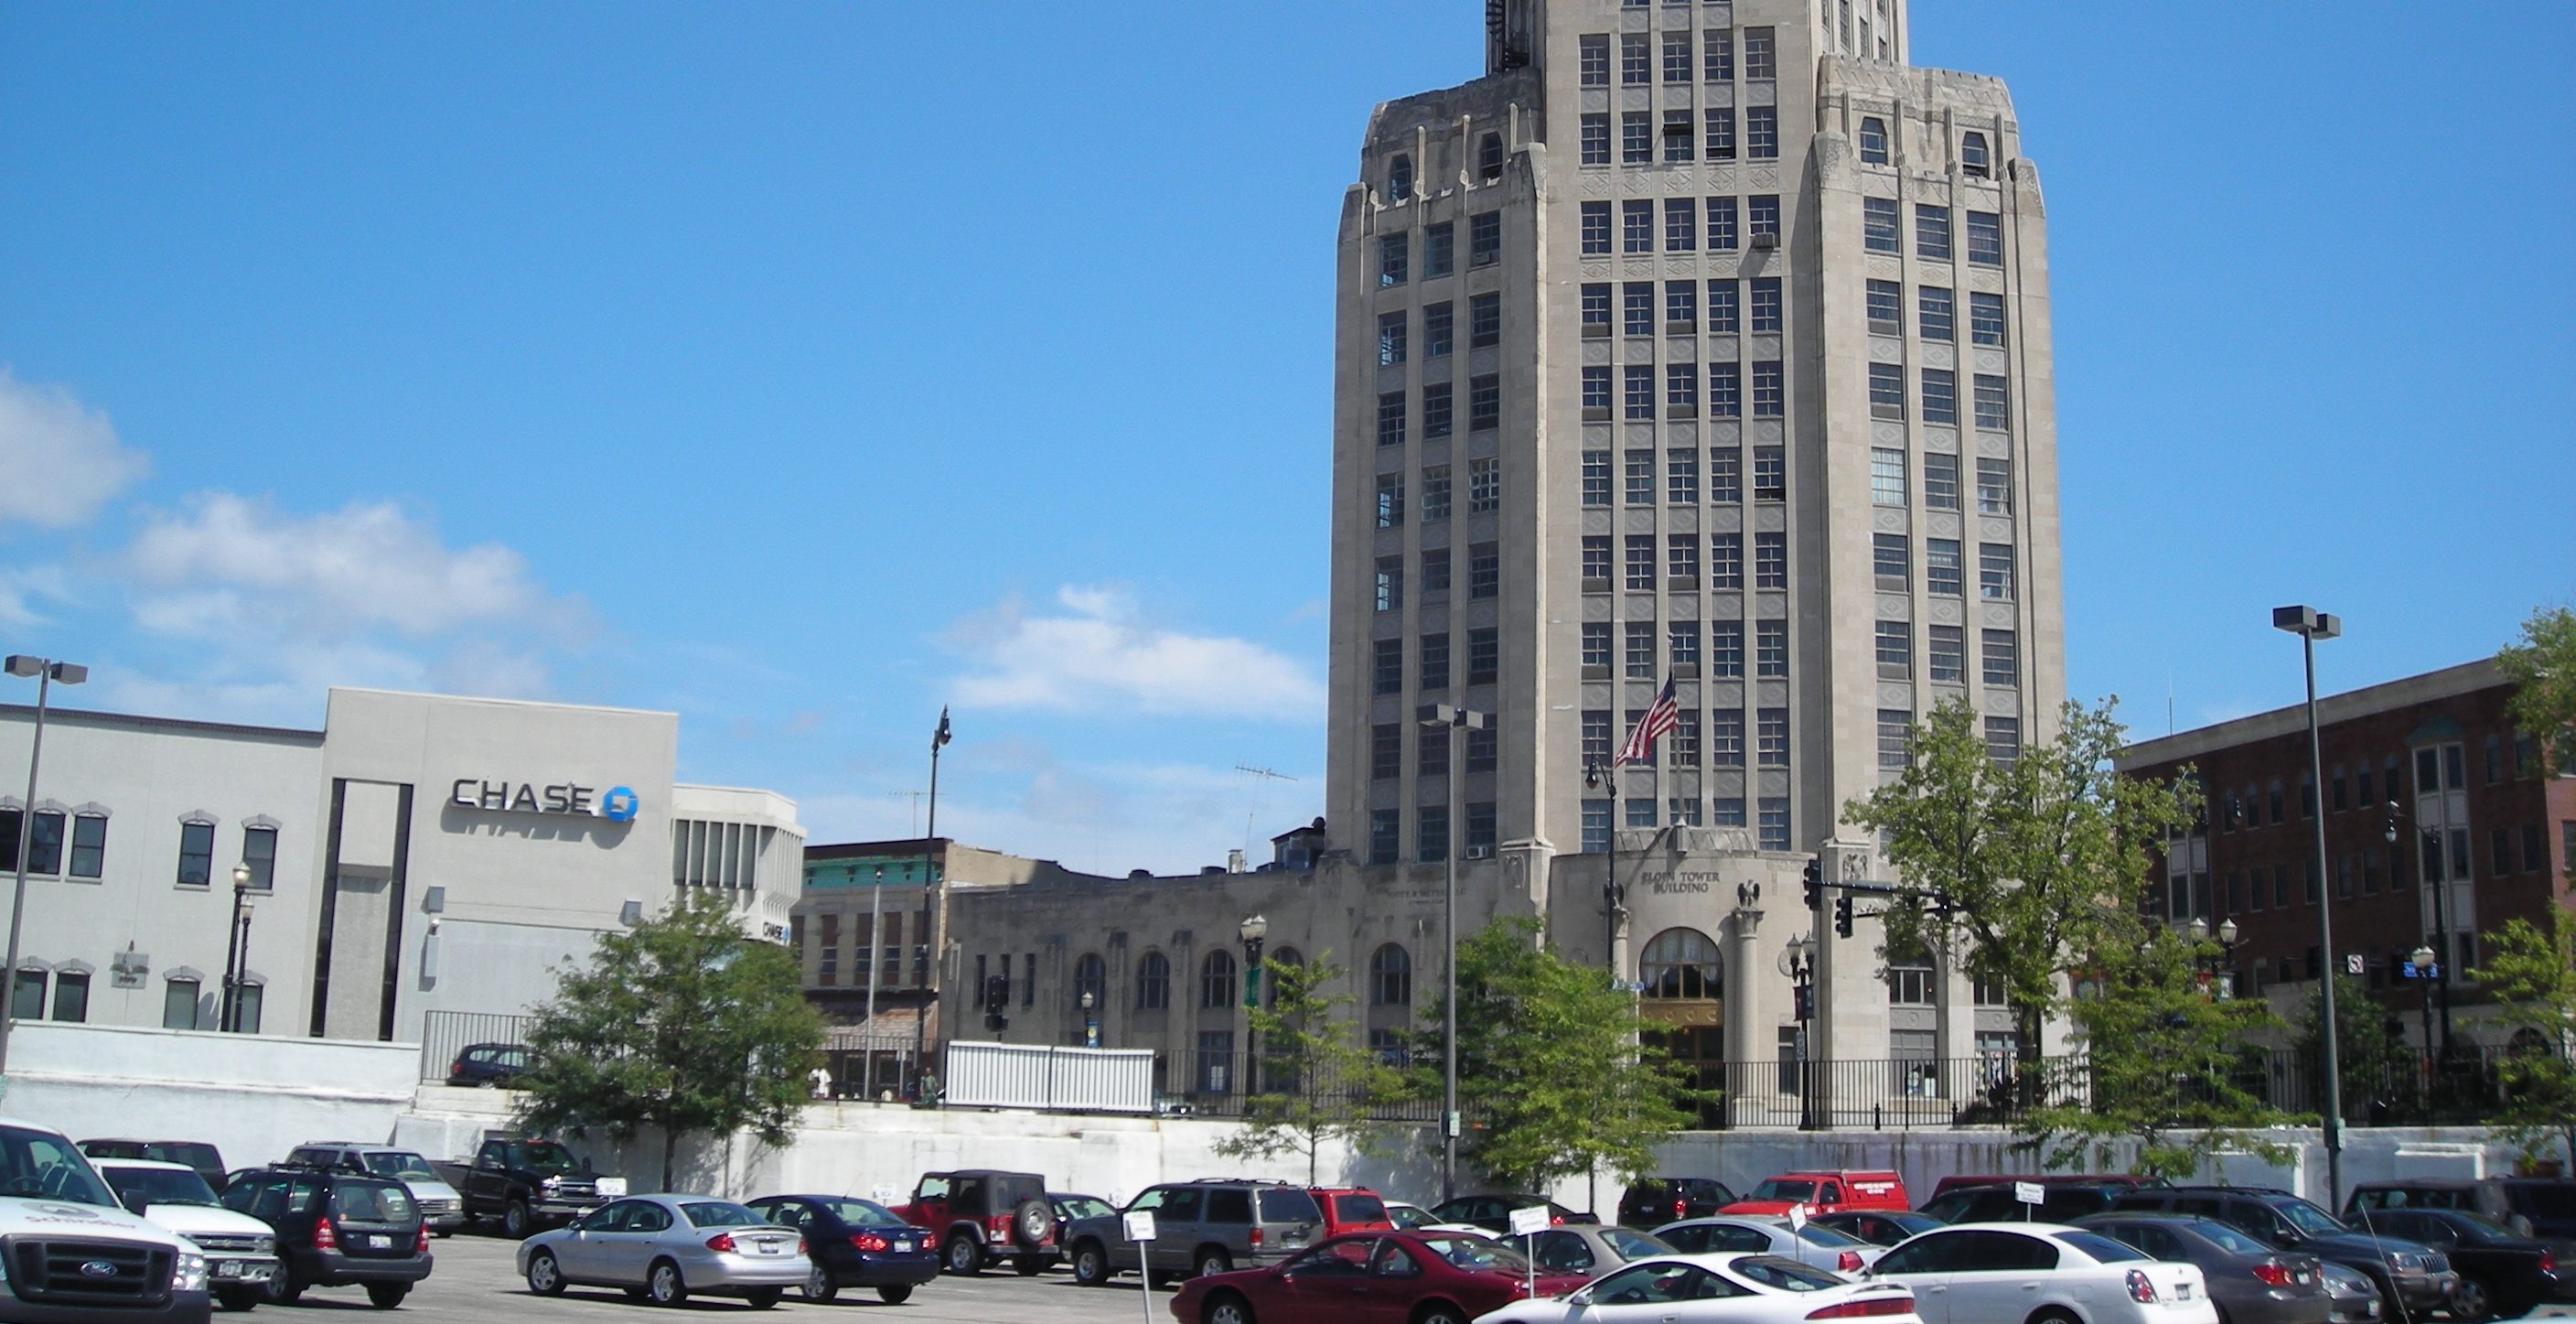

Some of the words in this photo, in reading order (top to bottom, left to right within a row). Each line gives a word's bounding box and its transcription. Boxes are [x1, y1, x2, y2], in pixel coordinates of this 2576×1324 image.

[452, 779, 595, 816] CHASE
[1641, 871, 1675, 882] ELGIN
[1680, 871, 1720, 882] TOWER
[1654, 882, 1709, 893] BUILDING
